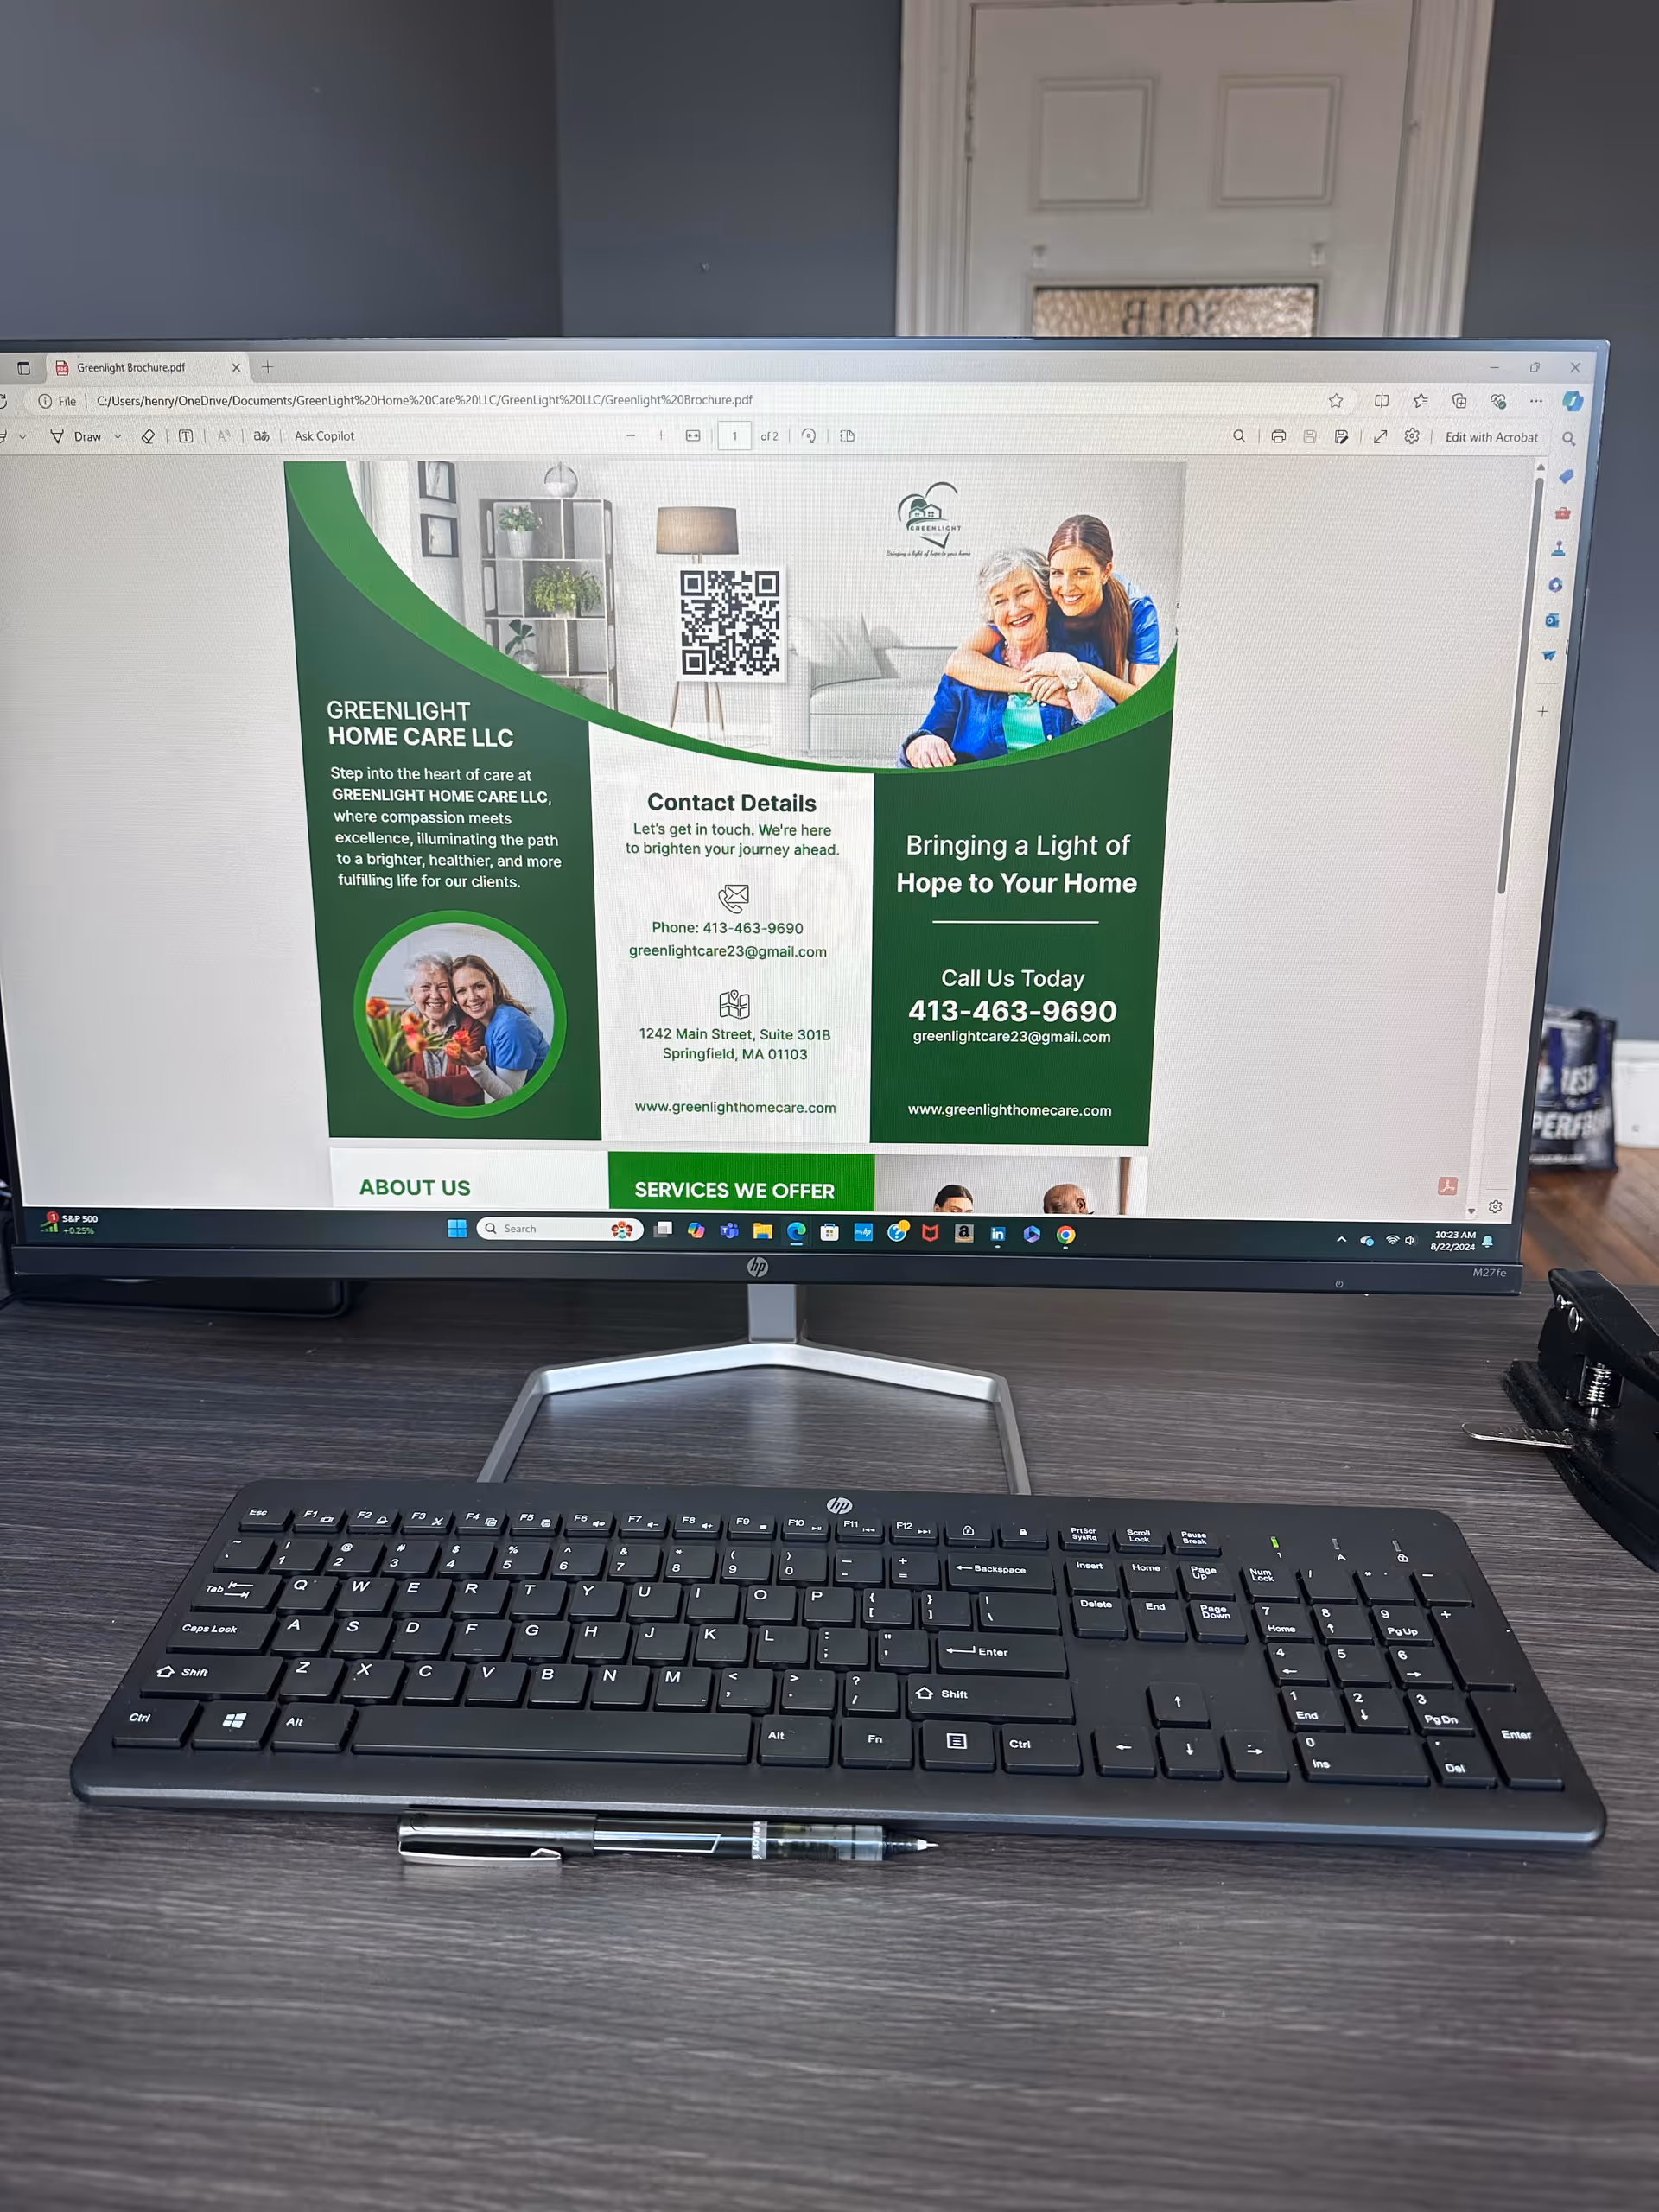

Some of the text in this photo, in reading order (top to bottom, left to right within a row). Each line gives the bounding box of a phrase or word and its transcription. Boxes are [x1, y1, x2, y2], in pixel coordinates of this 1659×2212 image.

[77, 362, 186, 374] Greenlight Brochure.pdf
[59, 396, 77, 407] File
[74, 431, 102, 442] Draw
[295, 430, 355, 444] Ask Copilot
[760, 431, 772, 442] of
[1446, 431, 1539, 443] Edit with Acrobat
[327, 700, 471, 721] GREENLIGHT
[327, 726, 514, 747] HOME CARE LLC
[330, 766, 532, 783] Step into the heart of care at
[332, 787, 552, 806] GREENLIGHT HOME CARE LLC,
[647, 792, 817, 813] Contact Details
[333, 810, 512, 826] where compassion meets
[633, 822, 832, 838] Let's get in touch. We're here
[334, 831, 559, 849] excellence, illuminating the path
[625, 842, 840, 859] to brighten your journey ahead.
[906, 833, 1132, 861] Bringing a Light of
[335, 852, 563, 869] to a brighter, healthier, and more
[337, 873, 521, 889] fulfilling life for our clients.
[897, 872, 1138, 898] Hope to Your Home
[652, 921, 804, 935] Phone: 413-463-9690
[629, 944, 827, 961] greenlightcare23@gmail.com
[941, 969, 1086, 992] Call Us Today
[908, 999, 1117, 1023] 413-463-9690
[639, 1027, 831, 1042] 1242 Main Street, Suite 301B
[912, 1029, 1111, 1046] greenlightcare23@gmail.com
[663, 1047, 808, 1063] Springfield, MA 01103
[634, 1101, 836, 1116] www.greenlighthomecare.com
[907, 1103, 1112, 1118] www.greenlighthomecare.com
[359, 1179, 471, 1197] ABOUT US
[634, 1181, 836, 1199] SERVICES WE OFFER
[61, 1214, 99, 1224] S&P 500
[63, 1226, 95, 1235] +0.25%
[504, 1224, 537, 1233] Search
[1435, 1230, 1477, 1239] 10:23 AM
[1430, 1243, 1476, 1252] 8/22/2024
[749, 1257, 769, 1279] hp
[1472, 1268, 1507, 1278] M27fe
[830, 1497, 850, 1514] hp
[303, 1510, 319, 1518] F1
[357, 1510, 372, 1519] F2
[411, 1511, 427, 1520] F3
[465, 1512, 480, 1521] F4
[519, 1513, 535, 1522] F5
[574, 1514, 588, 1522] F6
[627, 1515, 643, 1523] F7
[788, 1518, 805, 1527] F10
[896, 1522, 913, 1530] F12
[1071, 1527, 1096, 1536] PrtScr
[1071, 1532, 1098, 1541] SysRq
[1180, 1530, 1207, 1541] Pause
[1128, 1534, 1151, 1543] Lock
[1182, 1536, 1207, 1545] Break
[971, 1564, 1027, 1575] Backspace
[1076, 1561, 1103, 1570] Insert
[1131, 1563, 1161, 1572] Home
[1190, 1566, 1217, 1578] Page
[1191, 1570, 1209, 1582] Up
[1249, 1567, 1272, 1577] Num
[1251, 1573, 1275, 1582] Lock
[205, 1584, 224, 1594] Tab
[293, 1580, 308, 1591] Q
[1080, 1599, 1113, 1609] Delete
[1145, 1602, 1166, 1611] End
[1199, 1604, 1230, 1617] Page
[1201, 1609, 1231, 1619] Down
[181, 1624, 238, 1634] Caps Lock
[1267, 1624, 1296, 1633] Home
[978, 1647, 1008, 1656] Enter
[181, 1668, 209, 1677] Shift
[941, 1689, 969, 1700] Shift
[129, 1712, 151, 1723] Ctrl
[1295, 1710, 1319, 1720] End
[285, 1717, 304, 1727] Alt
[767, 1731, 785, 1740] Alt
[868, 1734, 883, 1744] Fn
[1501, 1730, 1532, 1740] Enter
[1008, 1739, 1032, 1749] Ctrl
[1312, 1758, 1331, 1769] Ins
[1445, 1763, 1466, 1774] Del
